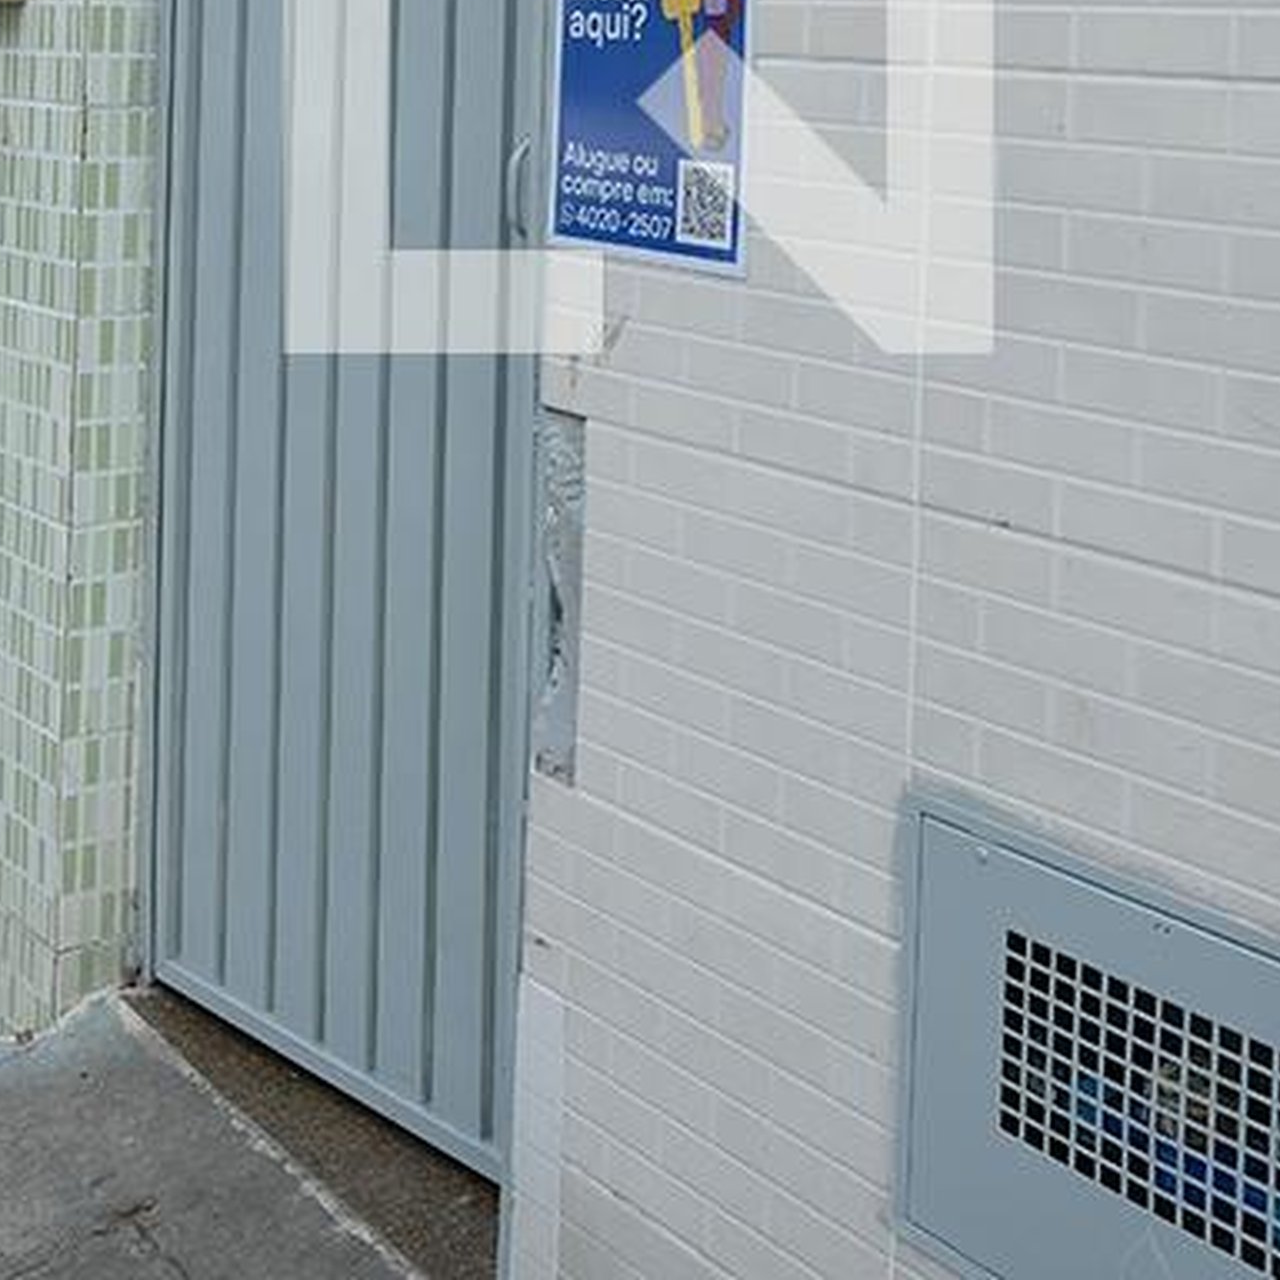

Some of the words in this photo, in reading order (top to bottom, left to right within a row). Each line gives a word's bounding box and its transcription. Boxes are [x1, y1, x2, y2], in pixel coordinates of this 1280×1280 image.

[569, 4, 649, 48] aqui?
[563, 142, 630, 177] Alugue
[632, 156, 658, 176] ou
[561, 175, 633, 204] compre
[636, 183, 674, 208] em:
